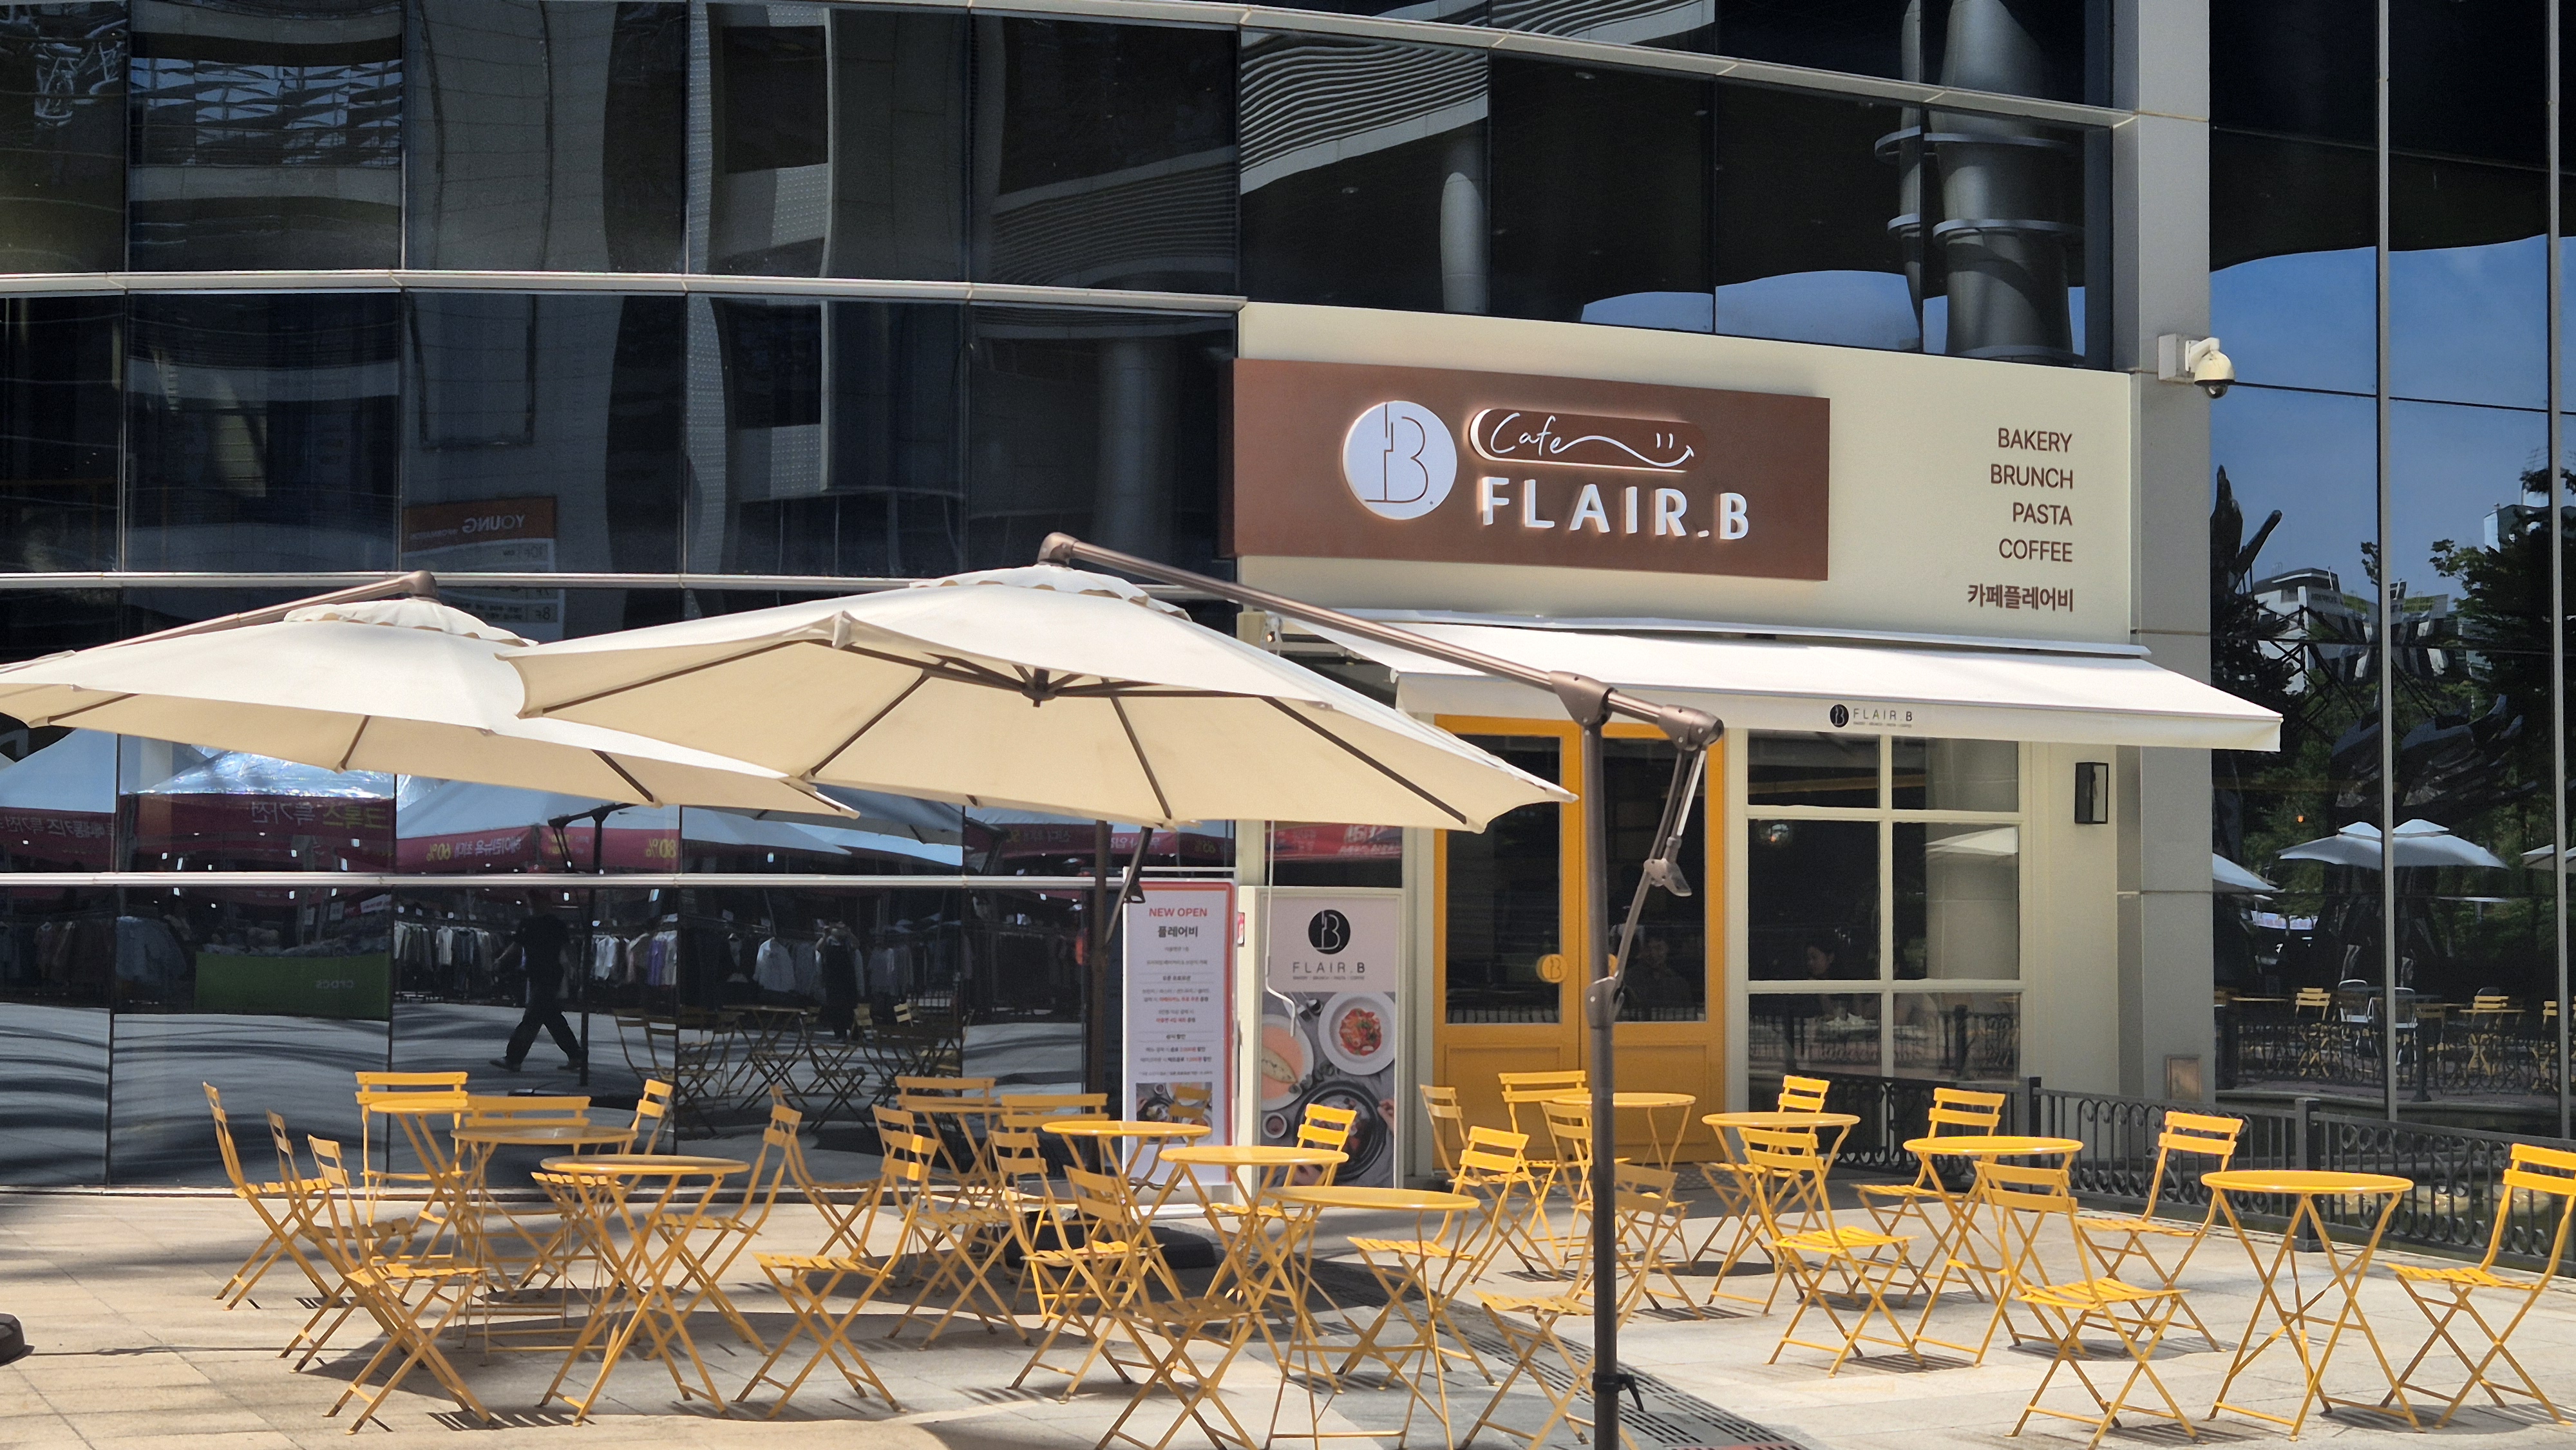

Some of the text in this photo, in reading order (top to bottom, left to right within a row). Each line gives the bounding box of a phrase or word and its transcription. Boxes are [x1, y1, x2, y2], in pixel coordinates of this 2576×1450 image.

[1997, 426, 2073, 453] BAKERY
[1989, 463, 2074, 490] BRUNCH
[1481, 475, 1750, 541] FLAIR.B
[2011, 501, 2073, 526] PASTA
[1998, 538, 2074, 563] COFFEE
[1966, 583, 2074, 613] 카페플레어비
[1149, 907, 1208, 918] NEW OPEN
[1157, 925, 1198, 938] 플레어비
